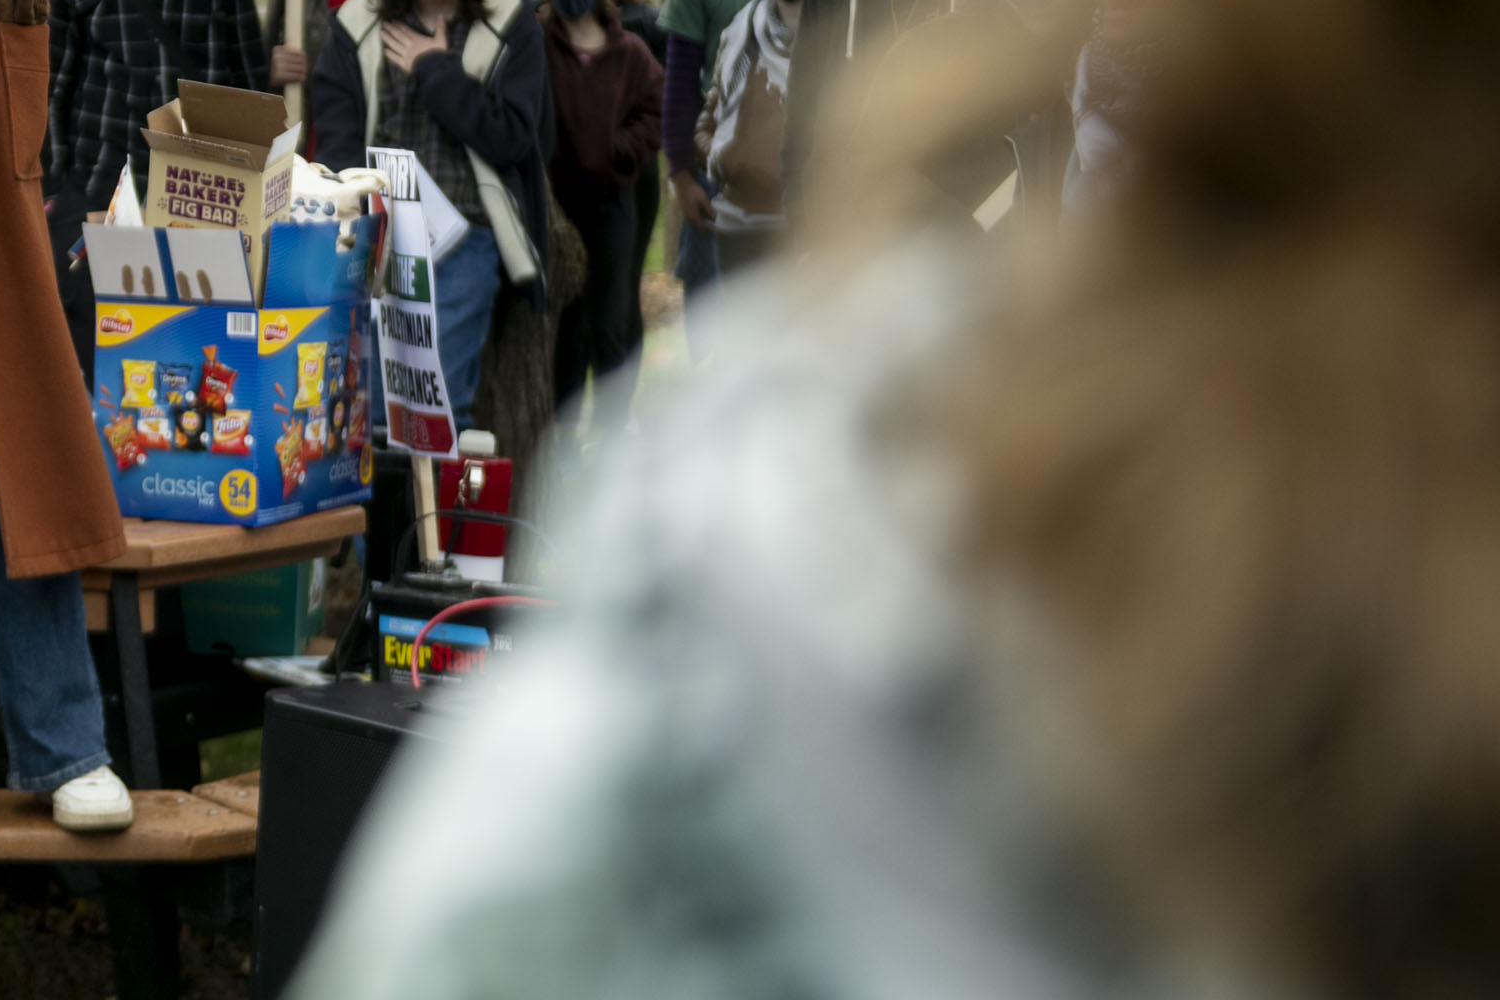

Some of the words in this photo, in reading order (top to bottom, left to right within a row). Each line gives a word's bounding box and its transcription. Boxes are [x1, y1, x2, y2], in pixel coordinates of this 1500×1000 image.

[165, 179, 245, 208] BAKERY
[171, 199, 198, 217] FIG
[201, 205, 234, 226] BAR
[142, 472, 216, 498] classic
[228, 476, 251, 500] 54
